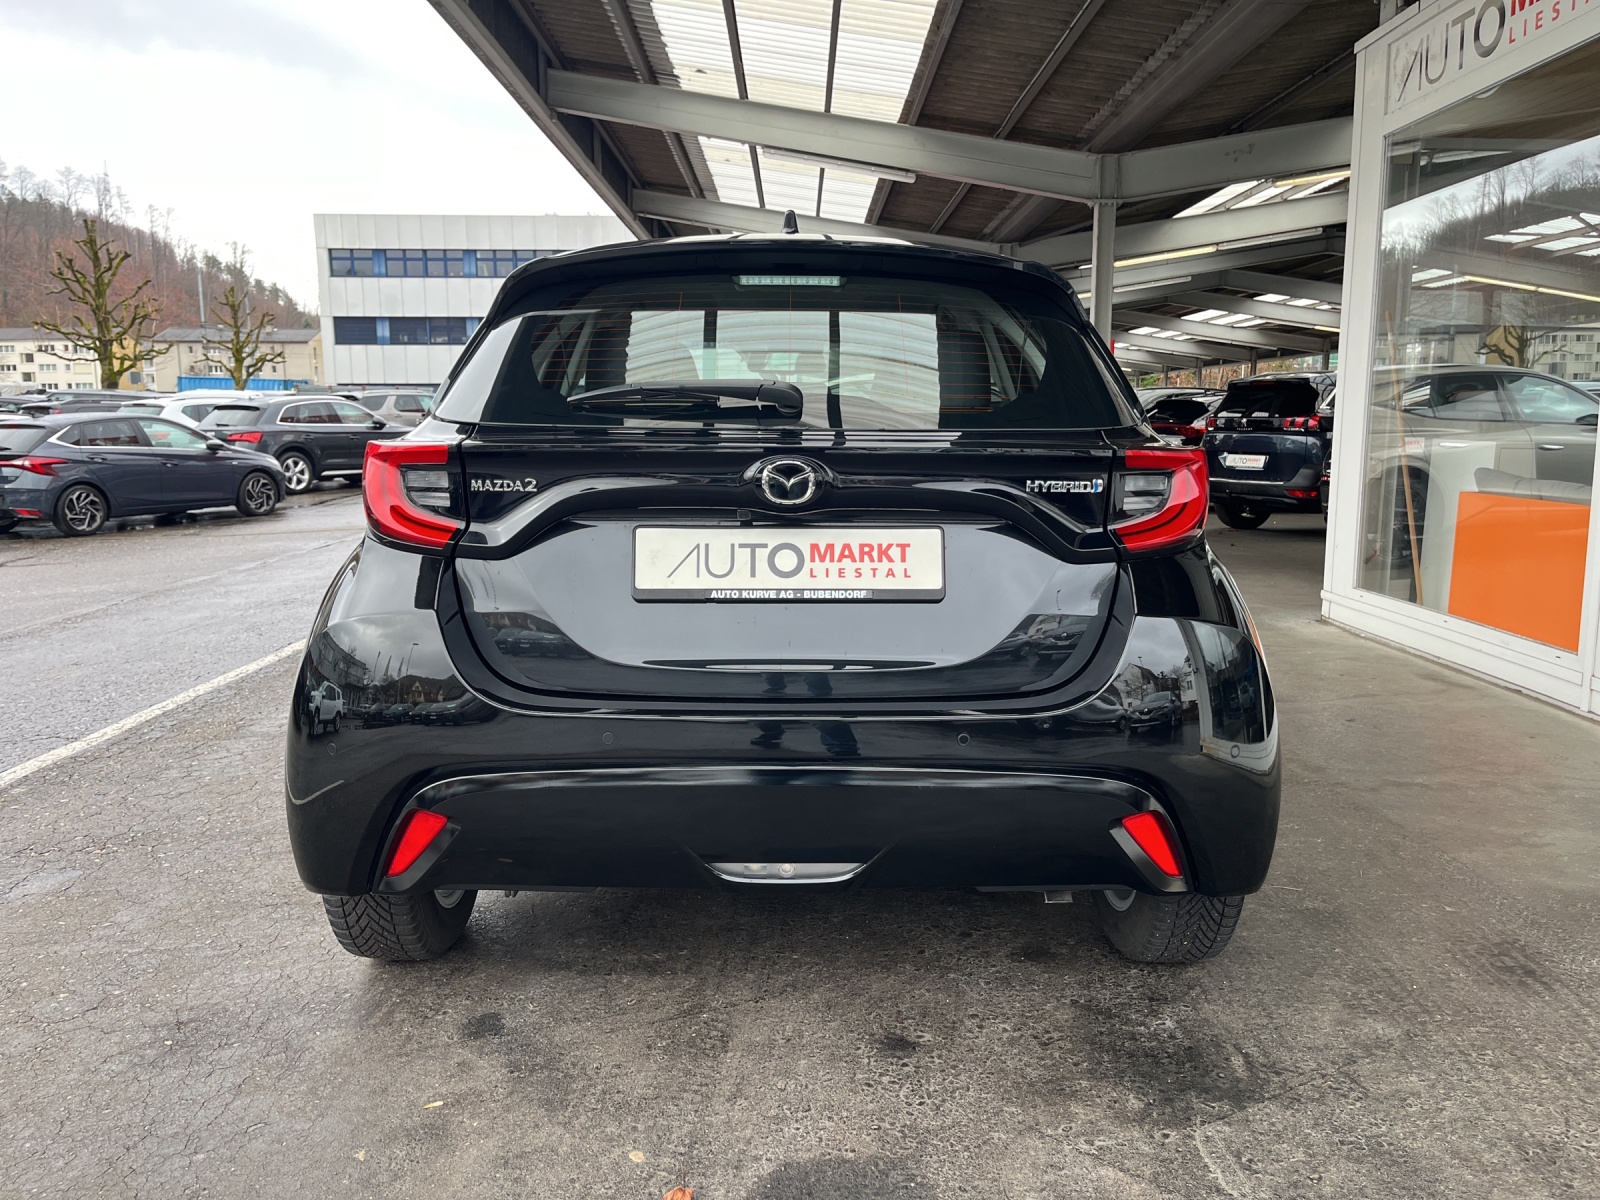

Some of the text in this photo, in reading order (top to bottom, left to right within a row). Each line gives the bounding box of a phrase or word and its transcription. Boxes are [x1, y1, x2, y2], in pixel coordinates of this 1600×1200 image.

[1397, 0, 1506, 102] AUTO
[470, 478, 538, 492] MAZDA2
[1026, 479, 1092, 493] HYBRID
[666, 542, 911, 579] AUTO MARKT
[809, 567, 912, 578] LIESTAL
[710, 590, 740, 599] AUTO
[741, 590, 777, 599] KURVE
[778, 590, 795, 599] AG
[803, 590, 868, 599] BUBENDORF
